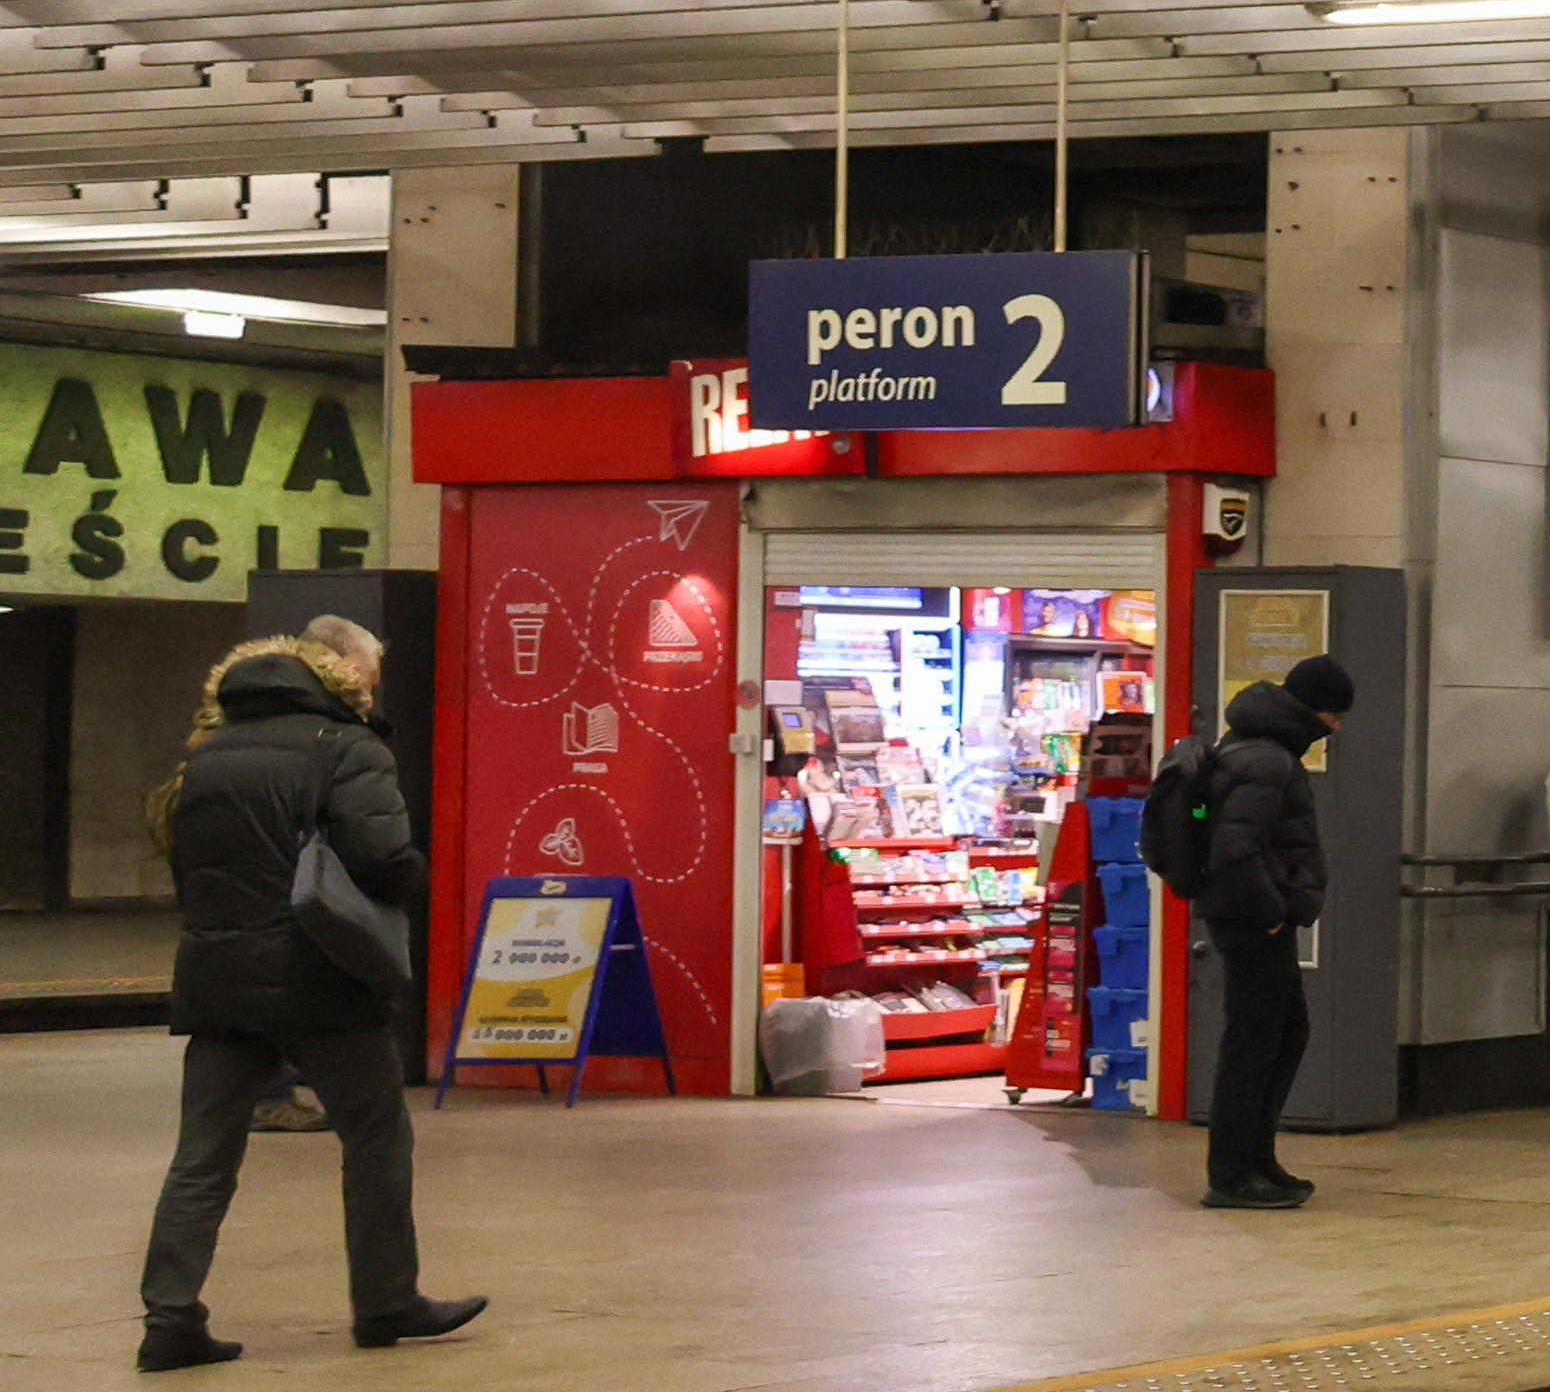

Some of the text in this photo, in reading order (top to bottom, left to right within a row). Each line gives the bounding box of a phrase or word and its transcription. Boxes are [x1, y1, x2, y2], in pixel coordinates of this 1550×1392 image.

[807, 294, 1067, 405] peron 2
[809, 368, 937, 410] platform
